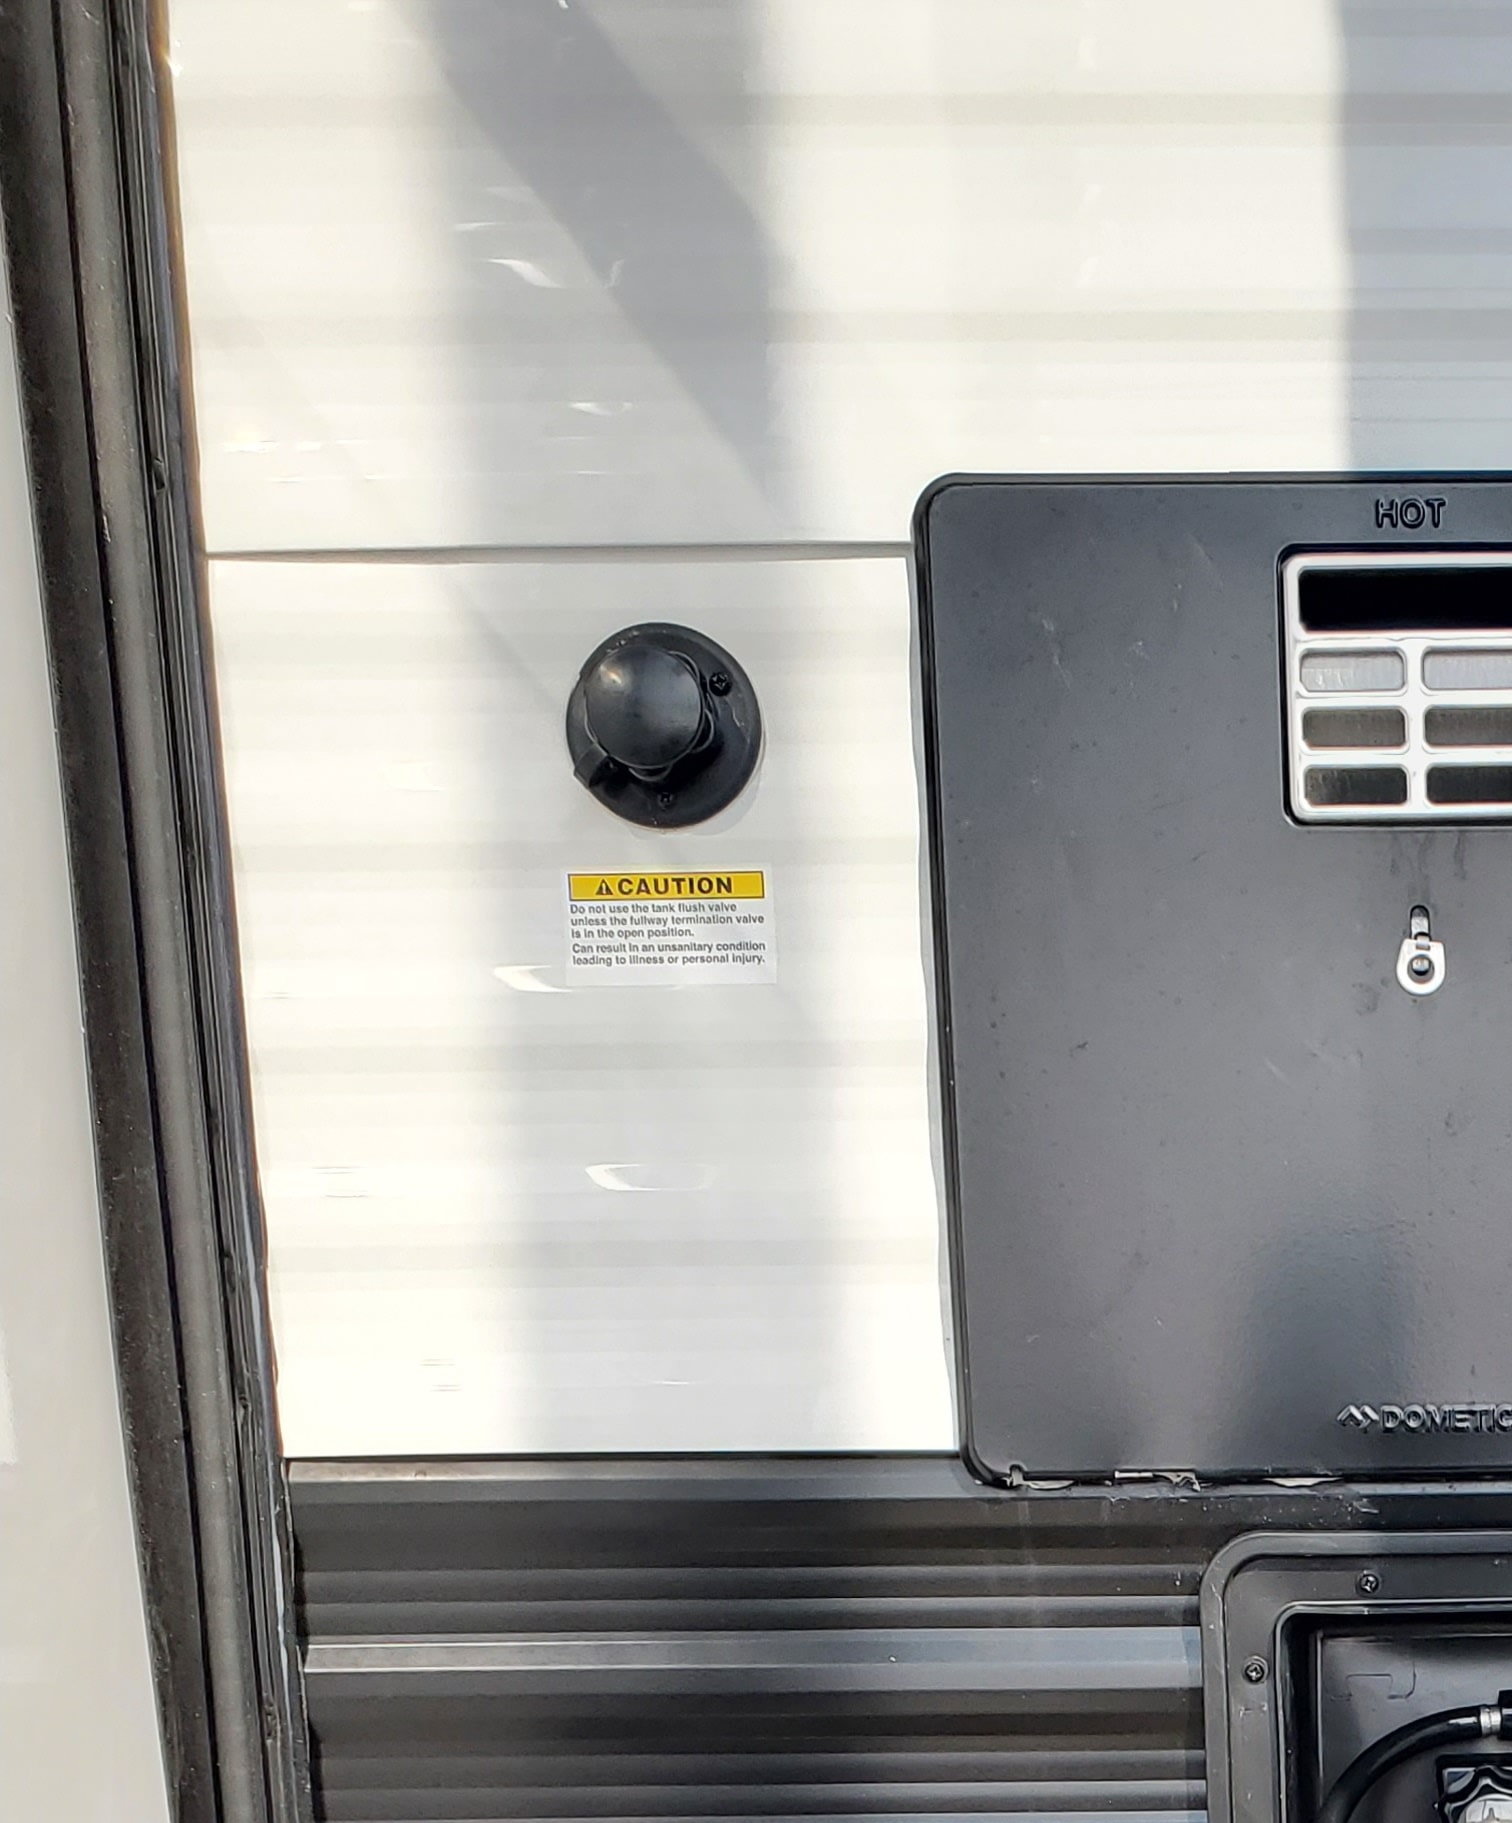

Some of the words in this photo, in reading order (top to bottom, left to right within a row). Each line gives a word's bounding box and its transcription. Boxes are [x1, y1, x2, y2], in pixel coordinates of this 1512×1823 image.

[1375, 498, 1446, 529] HOT
[618, 877, 732, 895] CAUTION
[570, 904, 585, 914] Do
[588, 903, 606, 914] not
[609, 904, 629, 913] use
[632, 903, 649, 913] the
[652, 902, 675, 913] tank
[678, 902, 705, 913] flush
[708, 902, 737, 912] valve
[571, 916, 607, 926] unless
[610, 915, 627, 926] the
[630, 915, 668, 928] fullway
[671, 914, 733, 926] termination
[735, 914, 764, 924] valve
[584, 928, 594, 938] in
[597, 928, 614, 938] the
[617, 929, 644, 939] open
[647, 928, 694, 939] position.
[572, 944, 593, 953] Can
[596, 943, 626, 953] result
[629, 943, 639, 952] in
[641, 944, 655, 952] an
[658, 942, 713, 954] unsanitary
[716, 941, 766, 951] condition
[573, 956, 612, 967] leading
[615, 956, 626, 965] to
[629, 955, 664, 965] illness
[667, 956, 679, 964] or
[682, 954, 729, 966] personal
[732, 953, 765, 965] injury.
